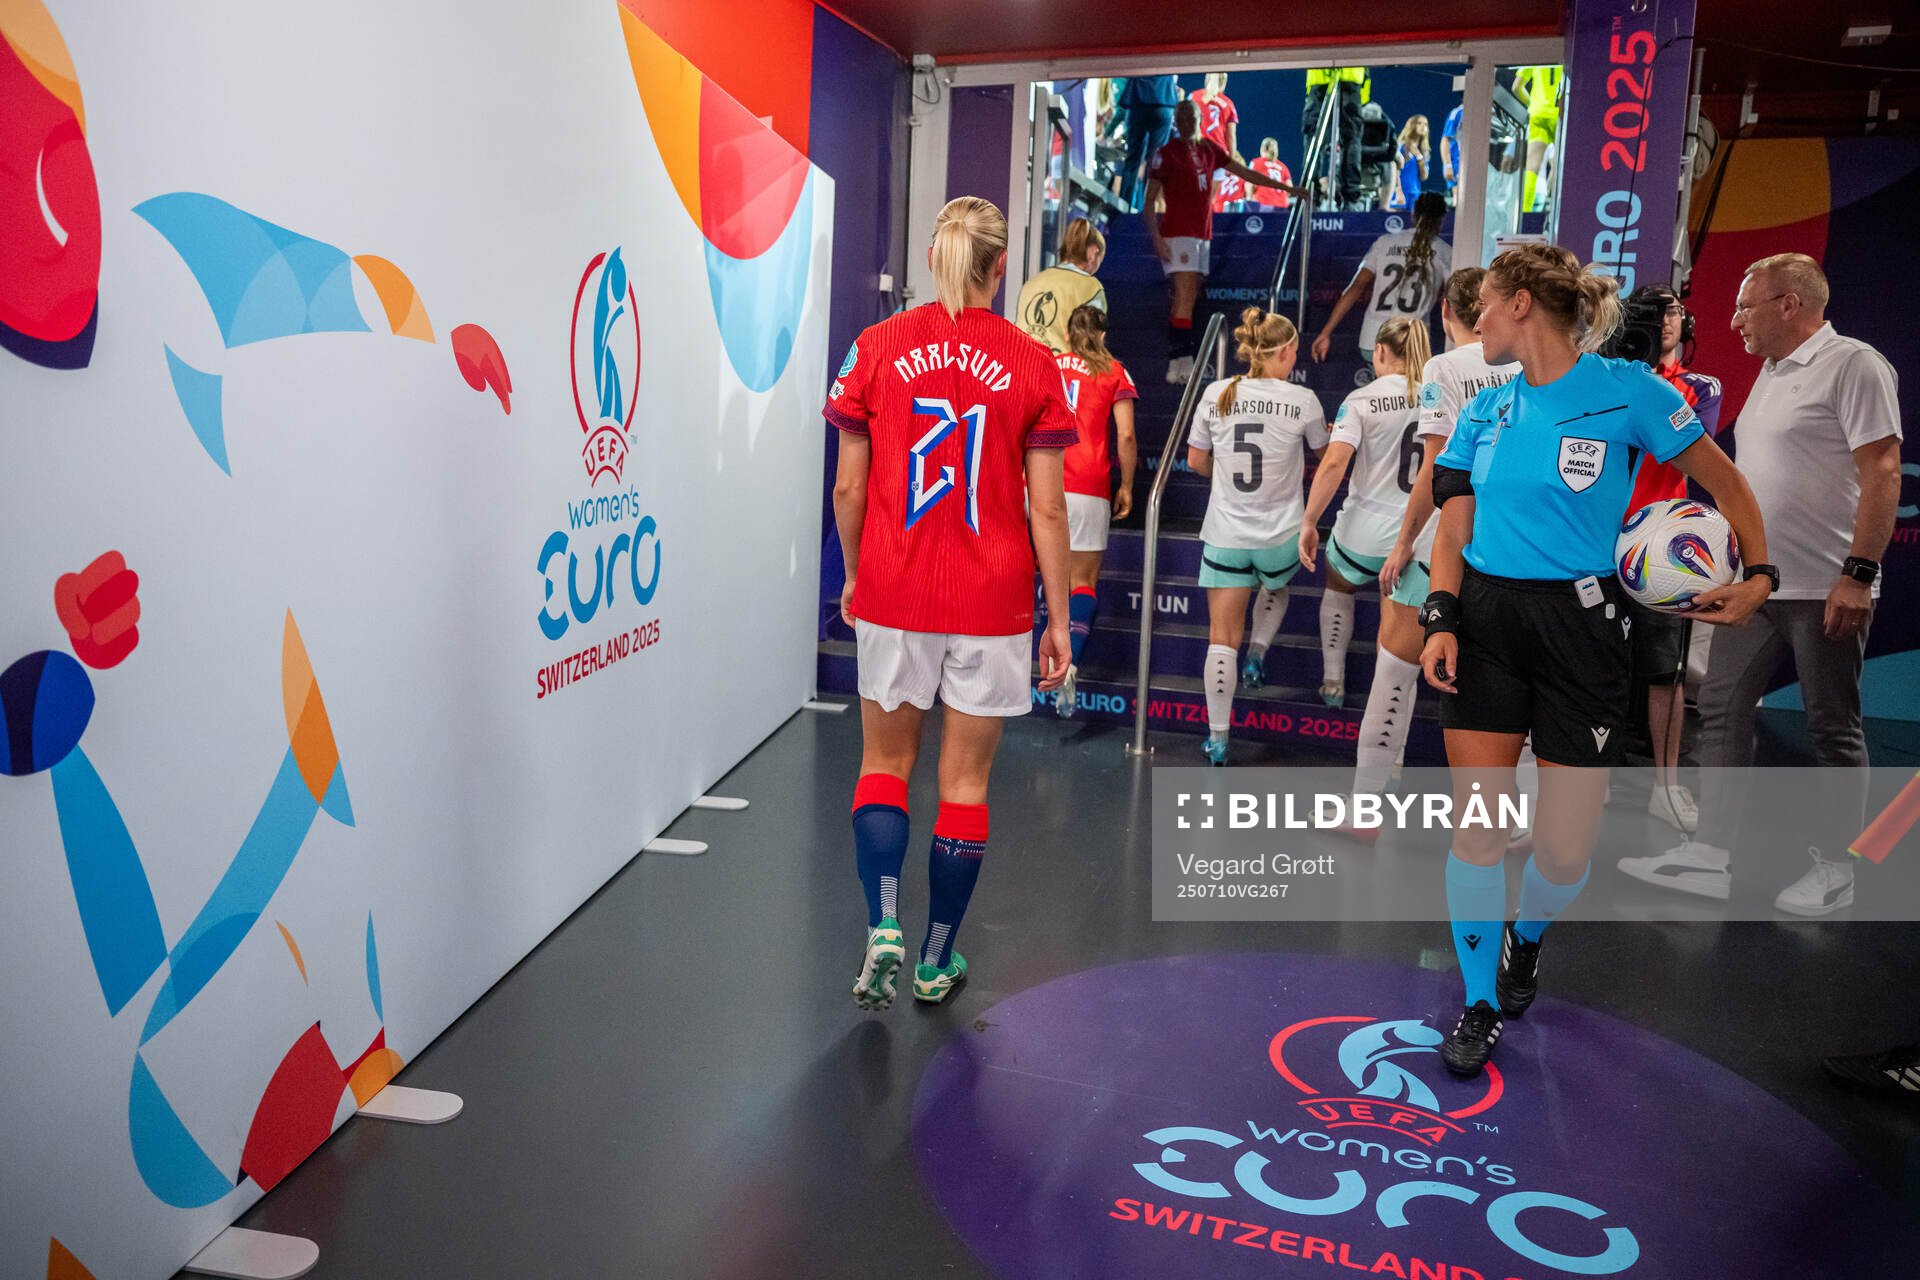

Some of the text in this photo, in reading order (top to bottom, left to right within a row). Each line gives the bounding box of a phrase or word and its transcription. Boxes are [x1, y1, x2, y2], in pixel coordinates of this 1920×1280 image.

[1600, 30, 1657, 173] 2025
[1310, 218, 1344, 231] HUN
[1205, 287, 1268, 300] WOMEN'S
[1376, 263, 1422, 313] 23
[894, 341, 1012, 392] NAALSUND
[585, 437, 625, 477] UEFA
[905, 396, 987, 537] 21
[1233, 423, 1265, 493] 5
[1397, 421, 1425, 494] 6
[1567, 459, 1595, 469] MATCH
[1569, 443, 1597, 457] UEFA
[1563, 467, 1596, 478] OFFICIAL
[1128, 592, 1188, 614] TUN
[537, 617, 661, 699] SWITZERLAND 2025
[1298, 716, 1359, 741] 2025
[1305, 1101, 1449, 1144] UEFA
